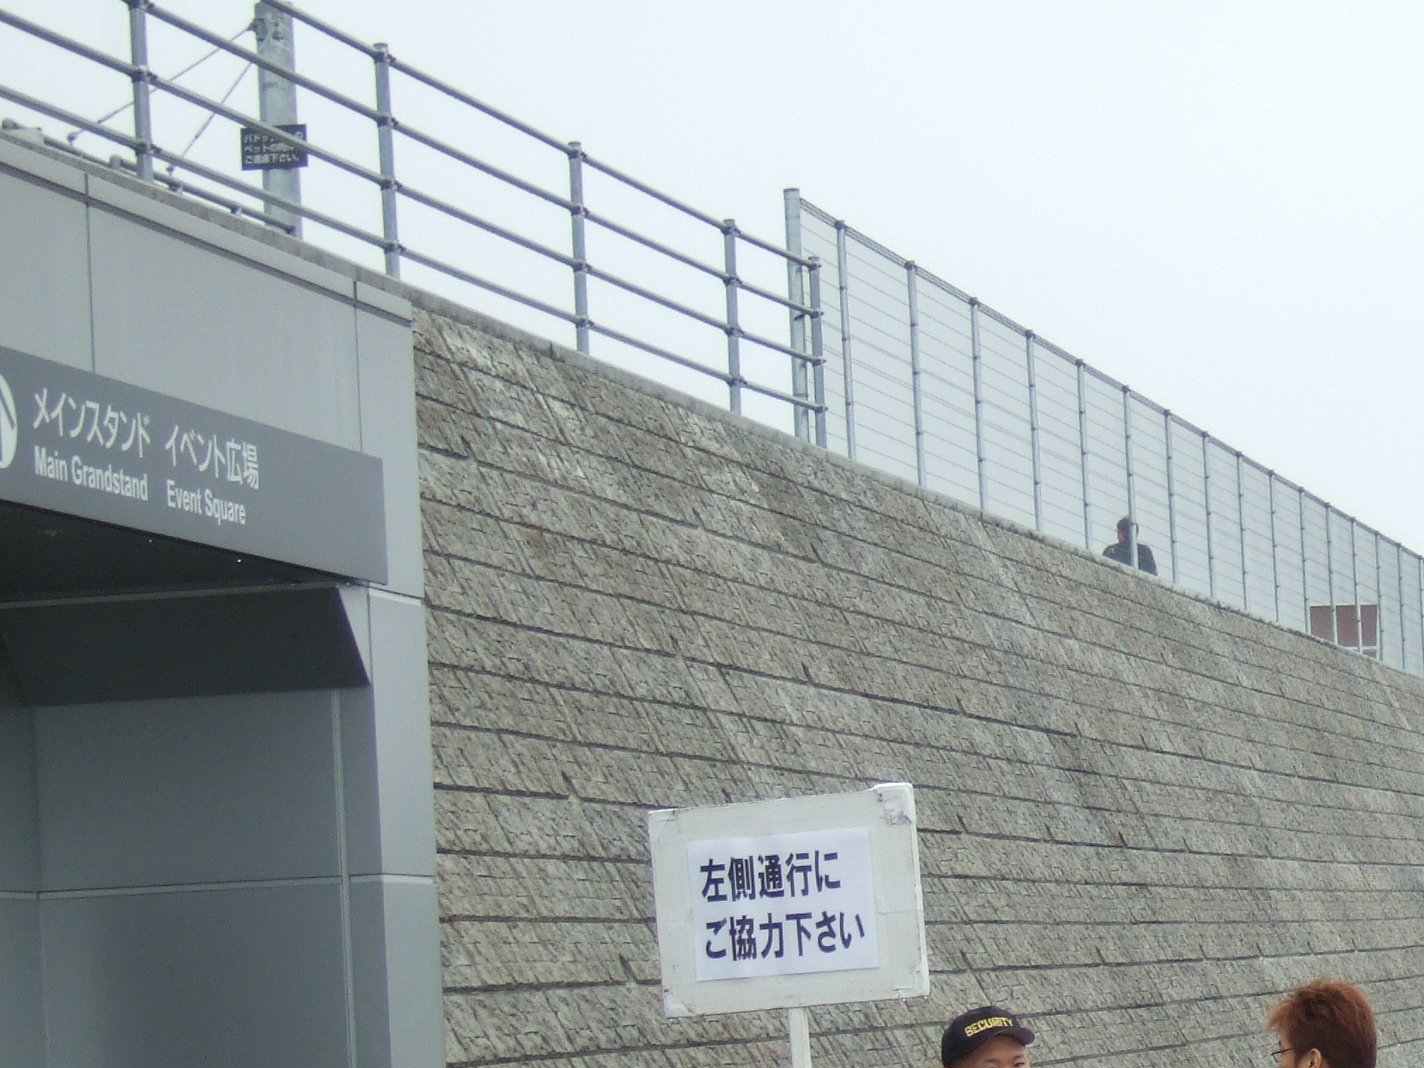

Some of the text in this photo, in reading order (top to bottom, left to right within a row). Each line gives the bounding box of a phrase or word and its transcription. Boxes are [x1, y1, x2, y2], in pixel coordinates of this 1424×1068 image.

[33, 387, 260, 490] メインスタンド イベント広場
[34, 446, 247, 526] Main Grandstand Event Square
[700, 850, 841, 902] 左側通行に
[705, 910, 865, 961] ご協力下さい
[964, 1016, 1015, 1037] SECURITY
